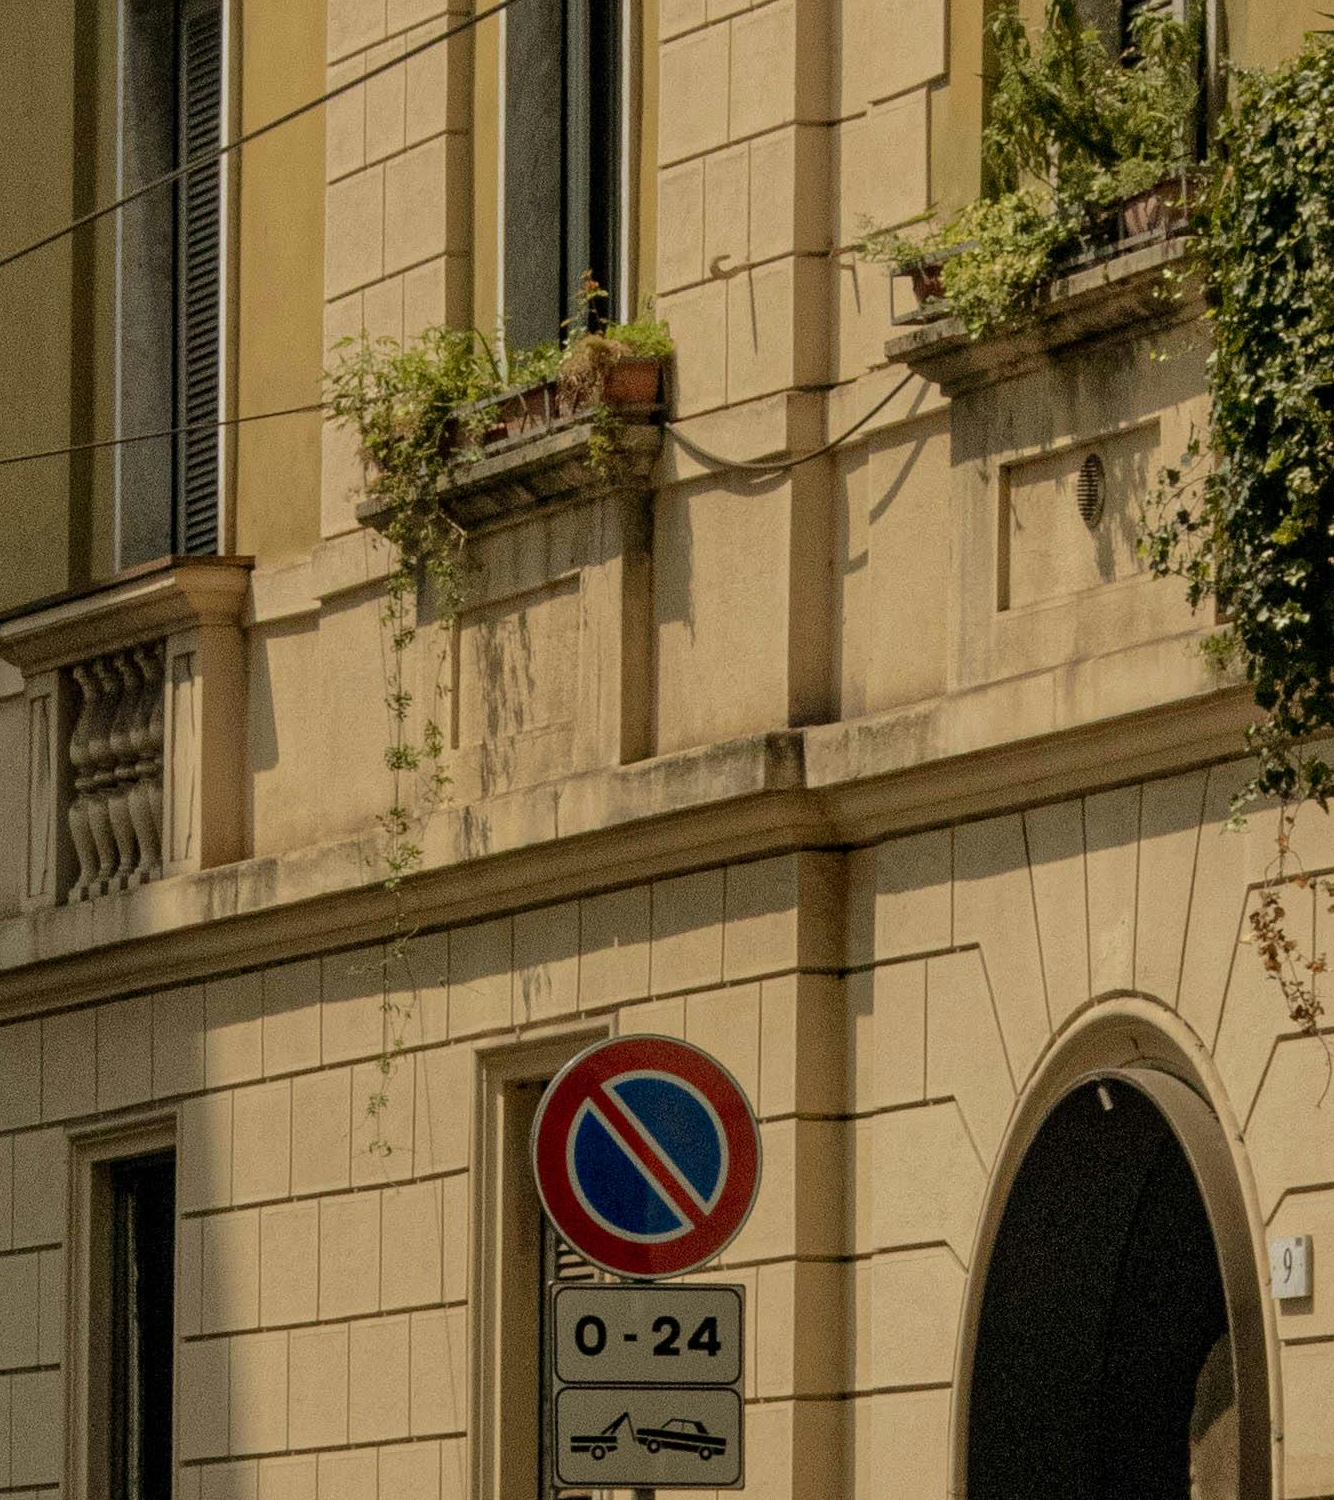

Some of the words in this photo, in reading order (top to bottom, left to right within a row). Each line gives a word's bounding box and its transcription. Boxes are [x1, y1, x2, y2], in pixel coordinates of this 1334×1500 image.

[1283, 1247, 1293, 1284] 9
[575, 1315, 607, 1356] 0
[652, 1315, 722, 1357] 24
